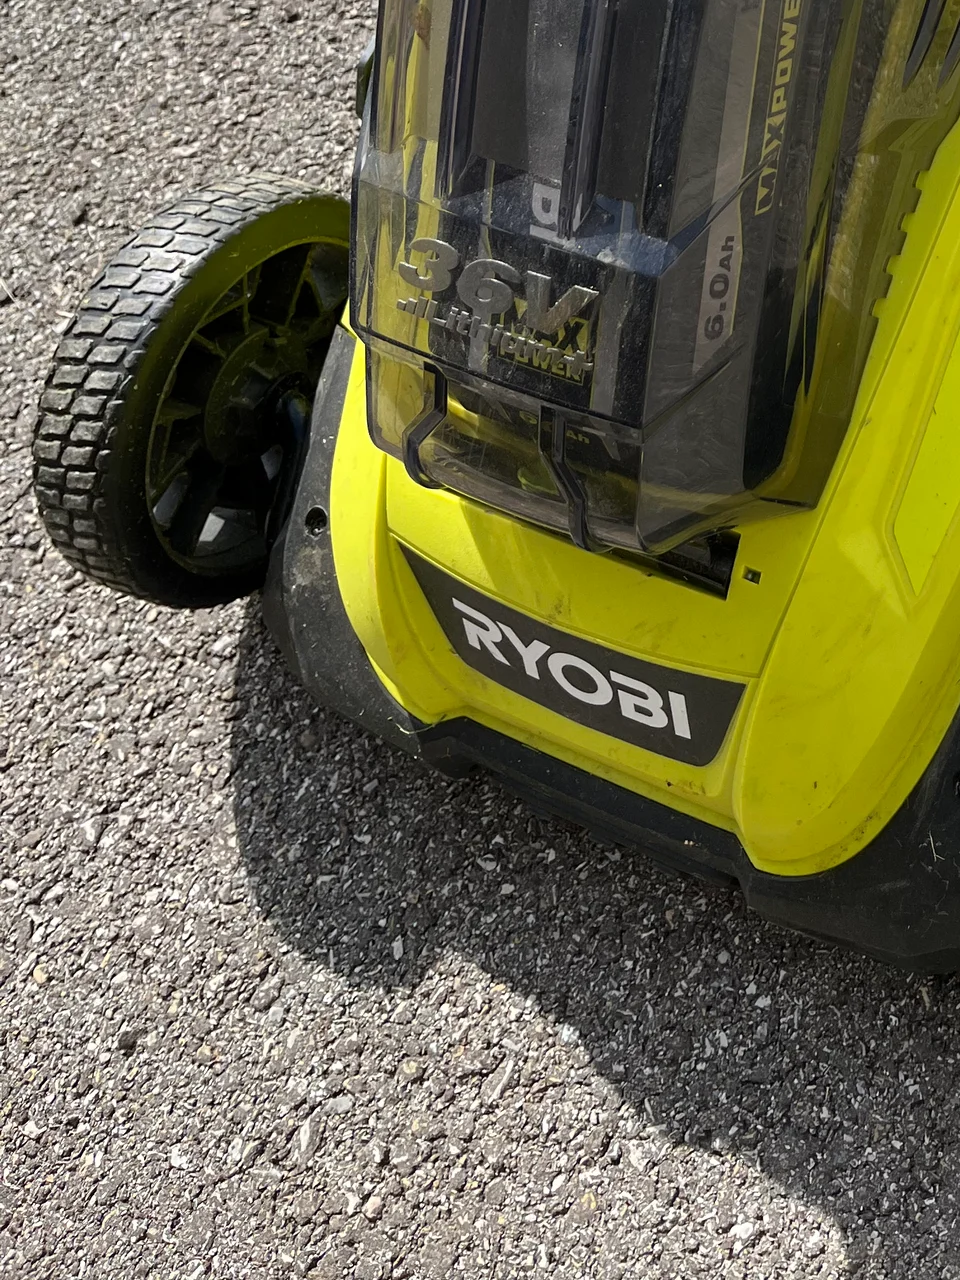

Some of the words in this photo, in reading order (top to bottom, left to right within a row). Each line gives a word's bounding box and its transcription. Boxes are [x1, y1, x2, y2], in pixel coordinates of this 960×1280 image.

[399, 237, 600, 336] 36V
[704, 234, 735, 341] 6.0Ah
[452, 597, 692, 740] RYOBI
